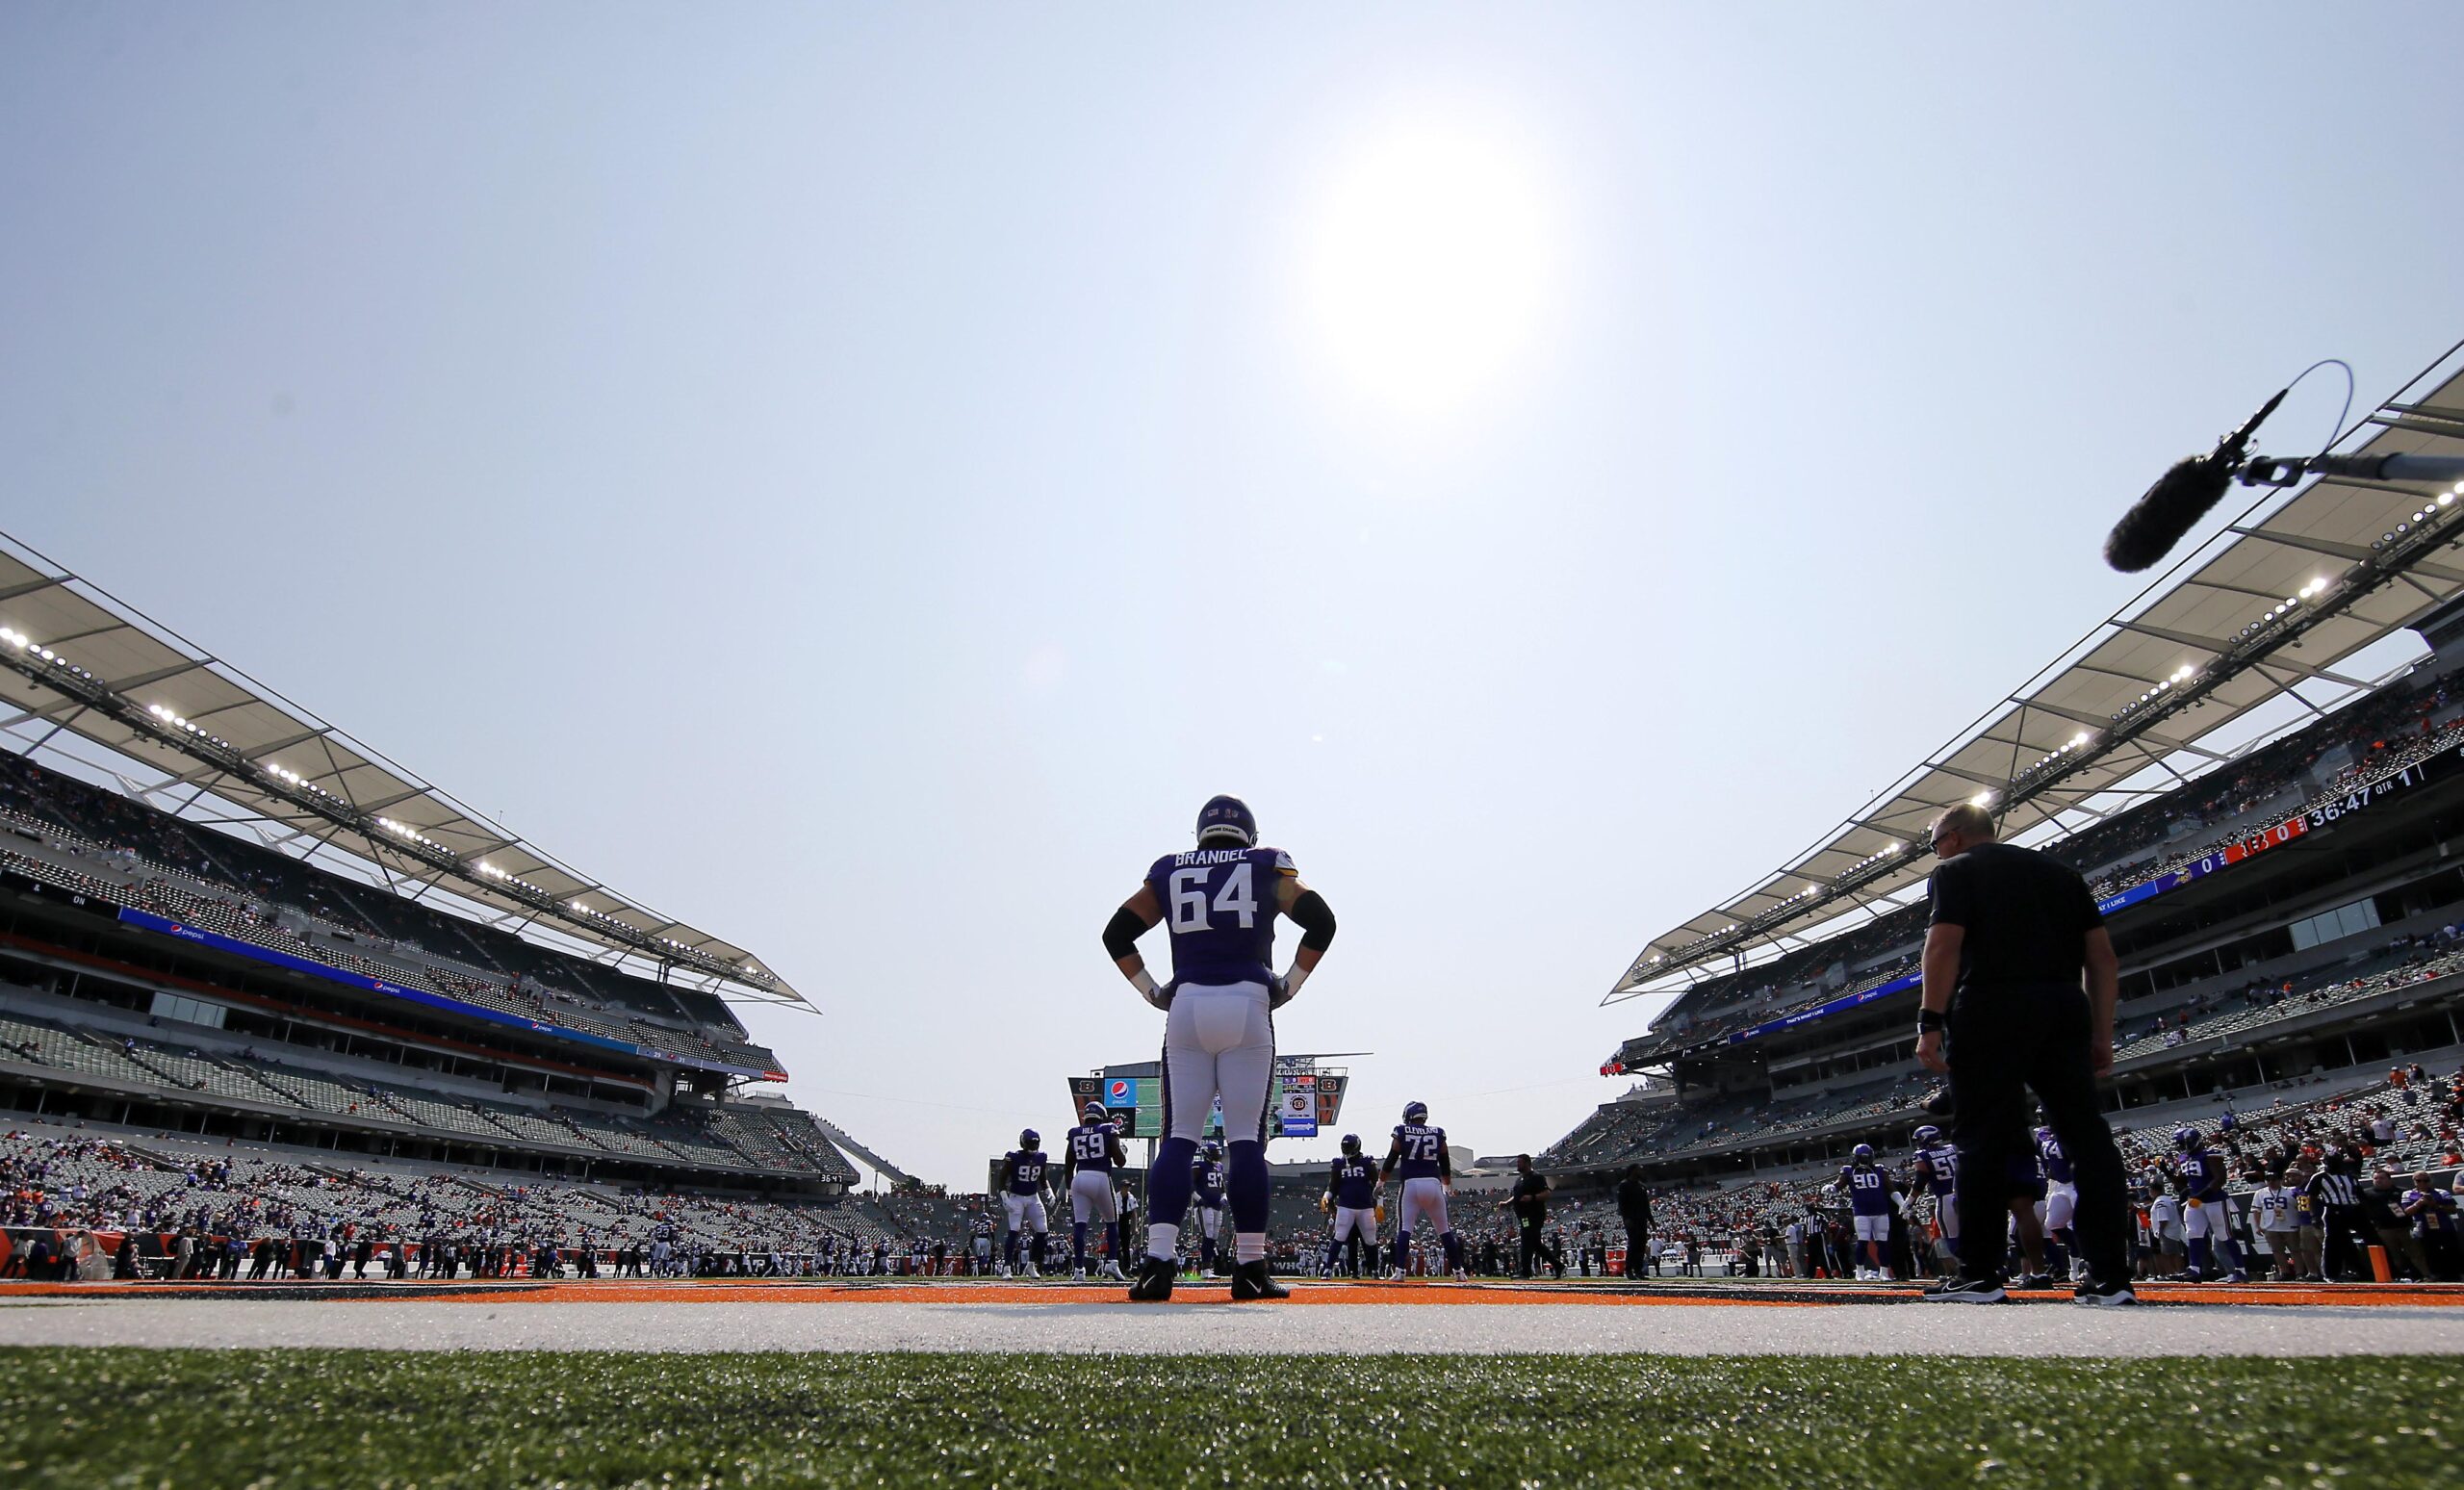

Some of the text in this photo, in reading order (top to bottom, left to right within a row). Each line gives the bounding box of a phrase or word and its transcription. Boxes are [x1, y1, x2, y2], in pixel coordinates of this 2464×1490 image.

[2311, 769, 2411, 827] 36:47 QTR 1
[2276, 825, 2289, 841] 0
[1174, 848, 1247, 866] BRANDEL
[2201, 858, 2213, 874] 0
[1169, 863, 1257, 934] 64
[2111, 896, 2125, 908] LIKE
[182, 929, 204, 940] pepsi
[382, 986, 400, 994] pepsi
[538, 1024, 552, 1033] pepsi
[1073, 1133, 1105, 1160] 69
[1405, 1135, 1438, 1161] 72
[1018, 1166, 1041, 1182] 98
[1207, 1171, 1223, 1188] 97
[1853, 1172, 1880, 1189] 90
[2263, 1196, 2288, 1210] 69
[656, 1227, 670, 1238] 23
[977, 1224, 988, 1234] 22
